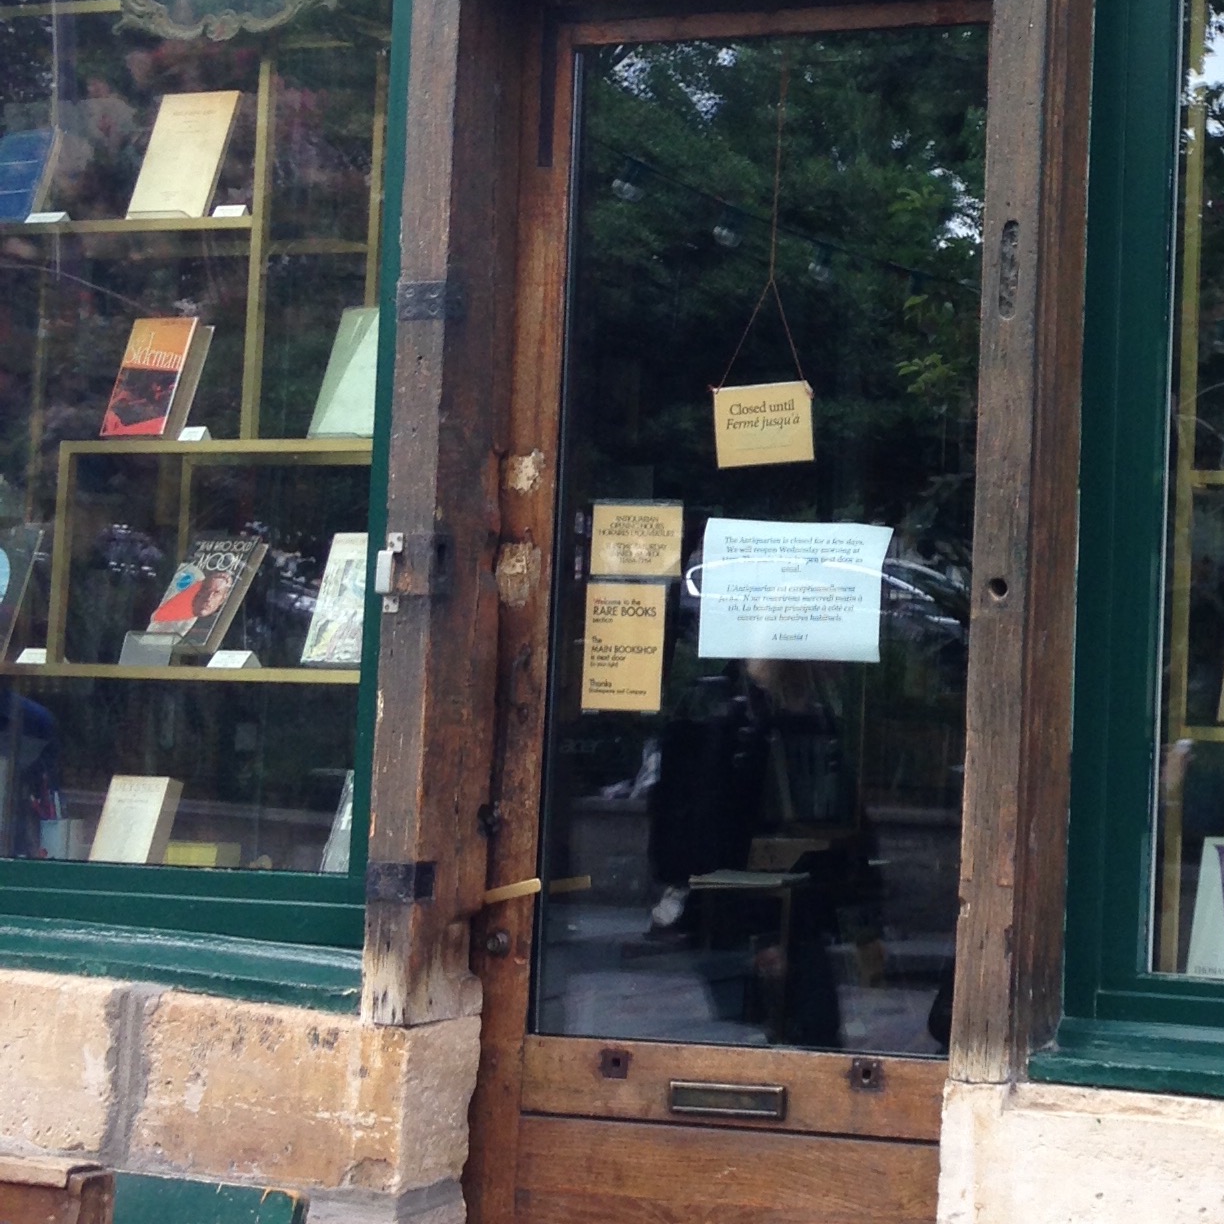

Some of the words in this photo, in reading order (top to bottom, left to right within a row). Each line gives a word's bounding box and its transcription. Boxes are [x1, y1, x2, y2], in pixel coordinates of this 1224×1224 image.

[730, 401, 766, 416] Closed
[768, 399, 795, 411] until
[726, 417, 759, 430] Fermé
[592, 606, 618, 616] RARE
[621, 606, 656, 617] BOOKS
